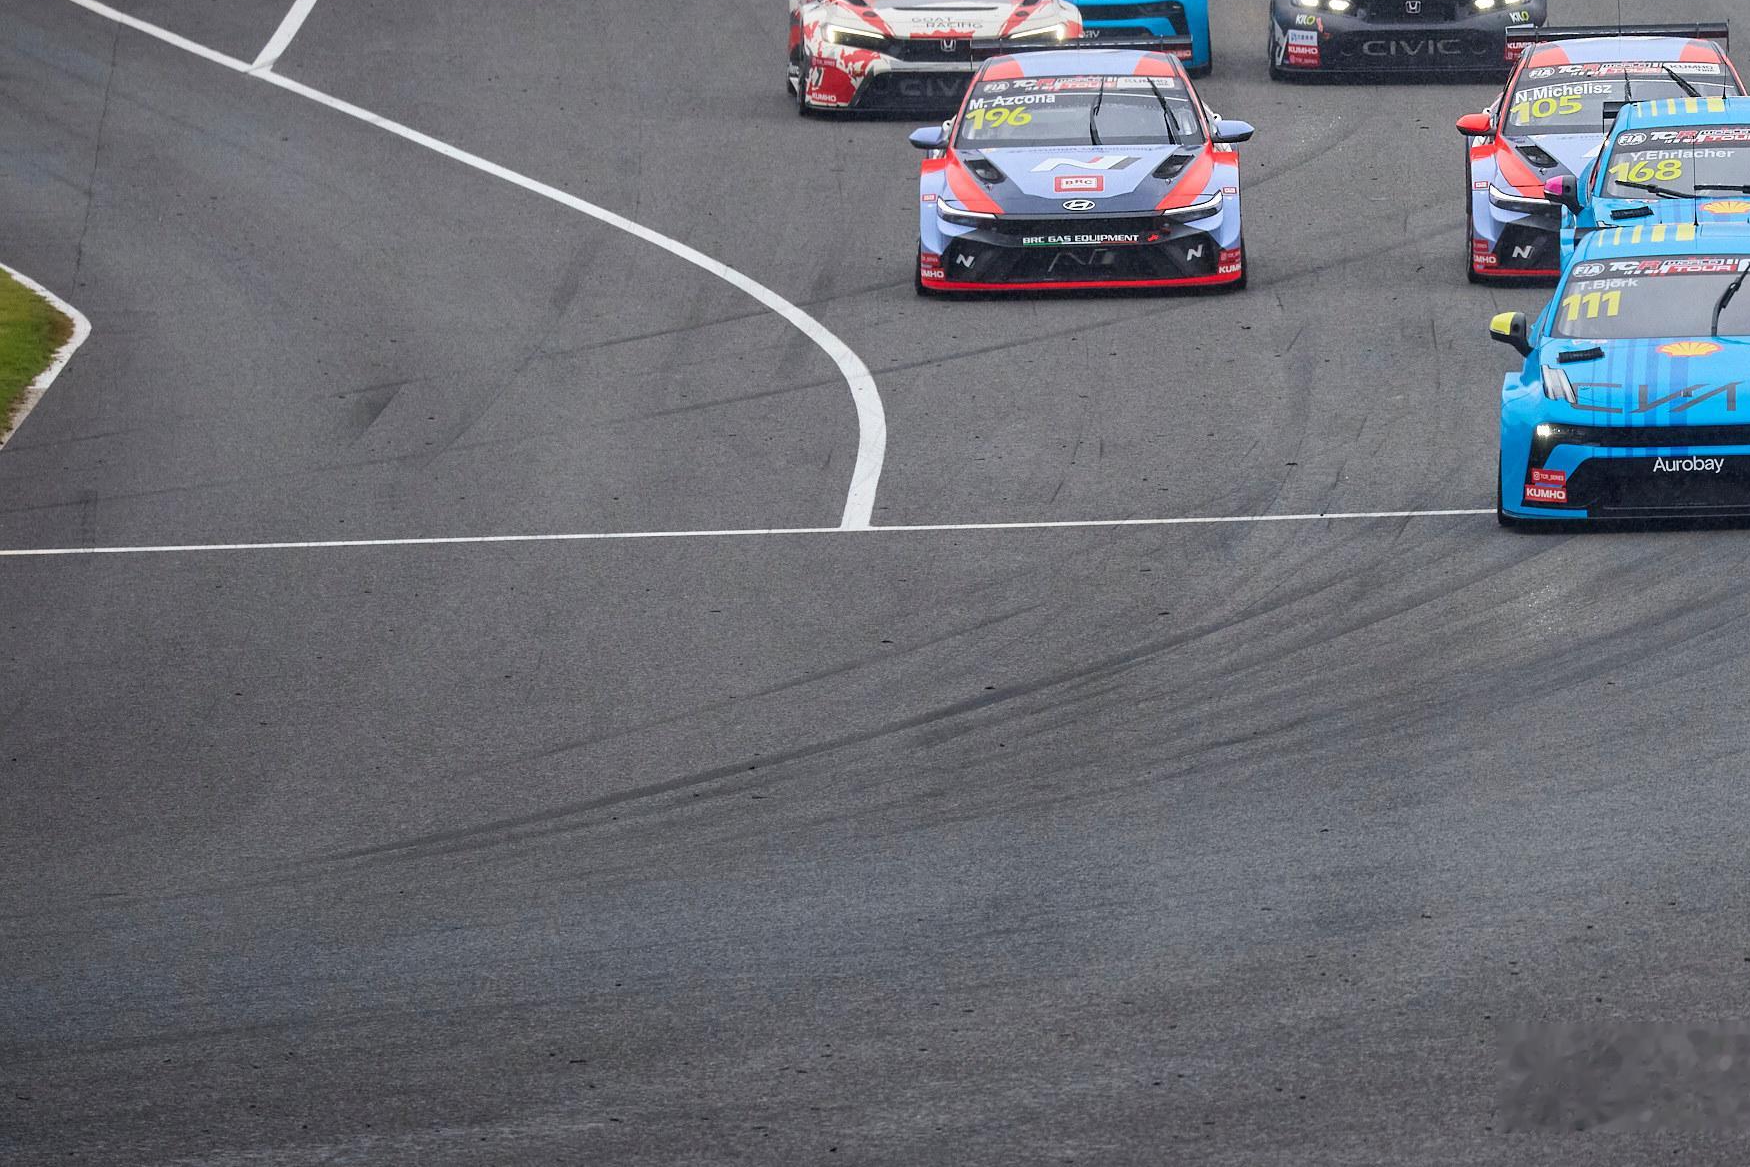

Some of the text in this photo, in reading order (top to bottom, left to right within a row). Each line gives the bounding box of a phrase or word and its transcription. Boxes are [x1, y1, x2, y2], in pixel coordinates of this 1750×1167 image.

[1362, 39, 1460, 57] CIVIC
[1531, 69, 1552, 77] FIA
[969, 93, 1056, 110] M. Azcona
[1510, 94, 1583, 124] 105
[965, 106, 1033, 131] 196
[1620, 134, 1645, 144] FIA
[1609, 159, 1682, 183] 168
[1022, 234, 1139, 245] BRC GAS EQUIPMENT
[1575, 265, 1602, 276] FIA
[1562, 290, 1622, 322] 111
[1653, 456, 1725, 474] Aurobay
[1526, 487, 1566, 501] KUMHO
